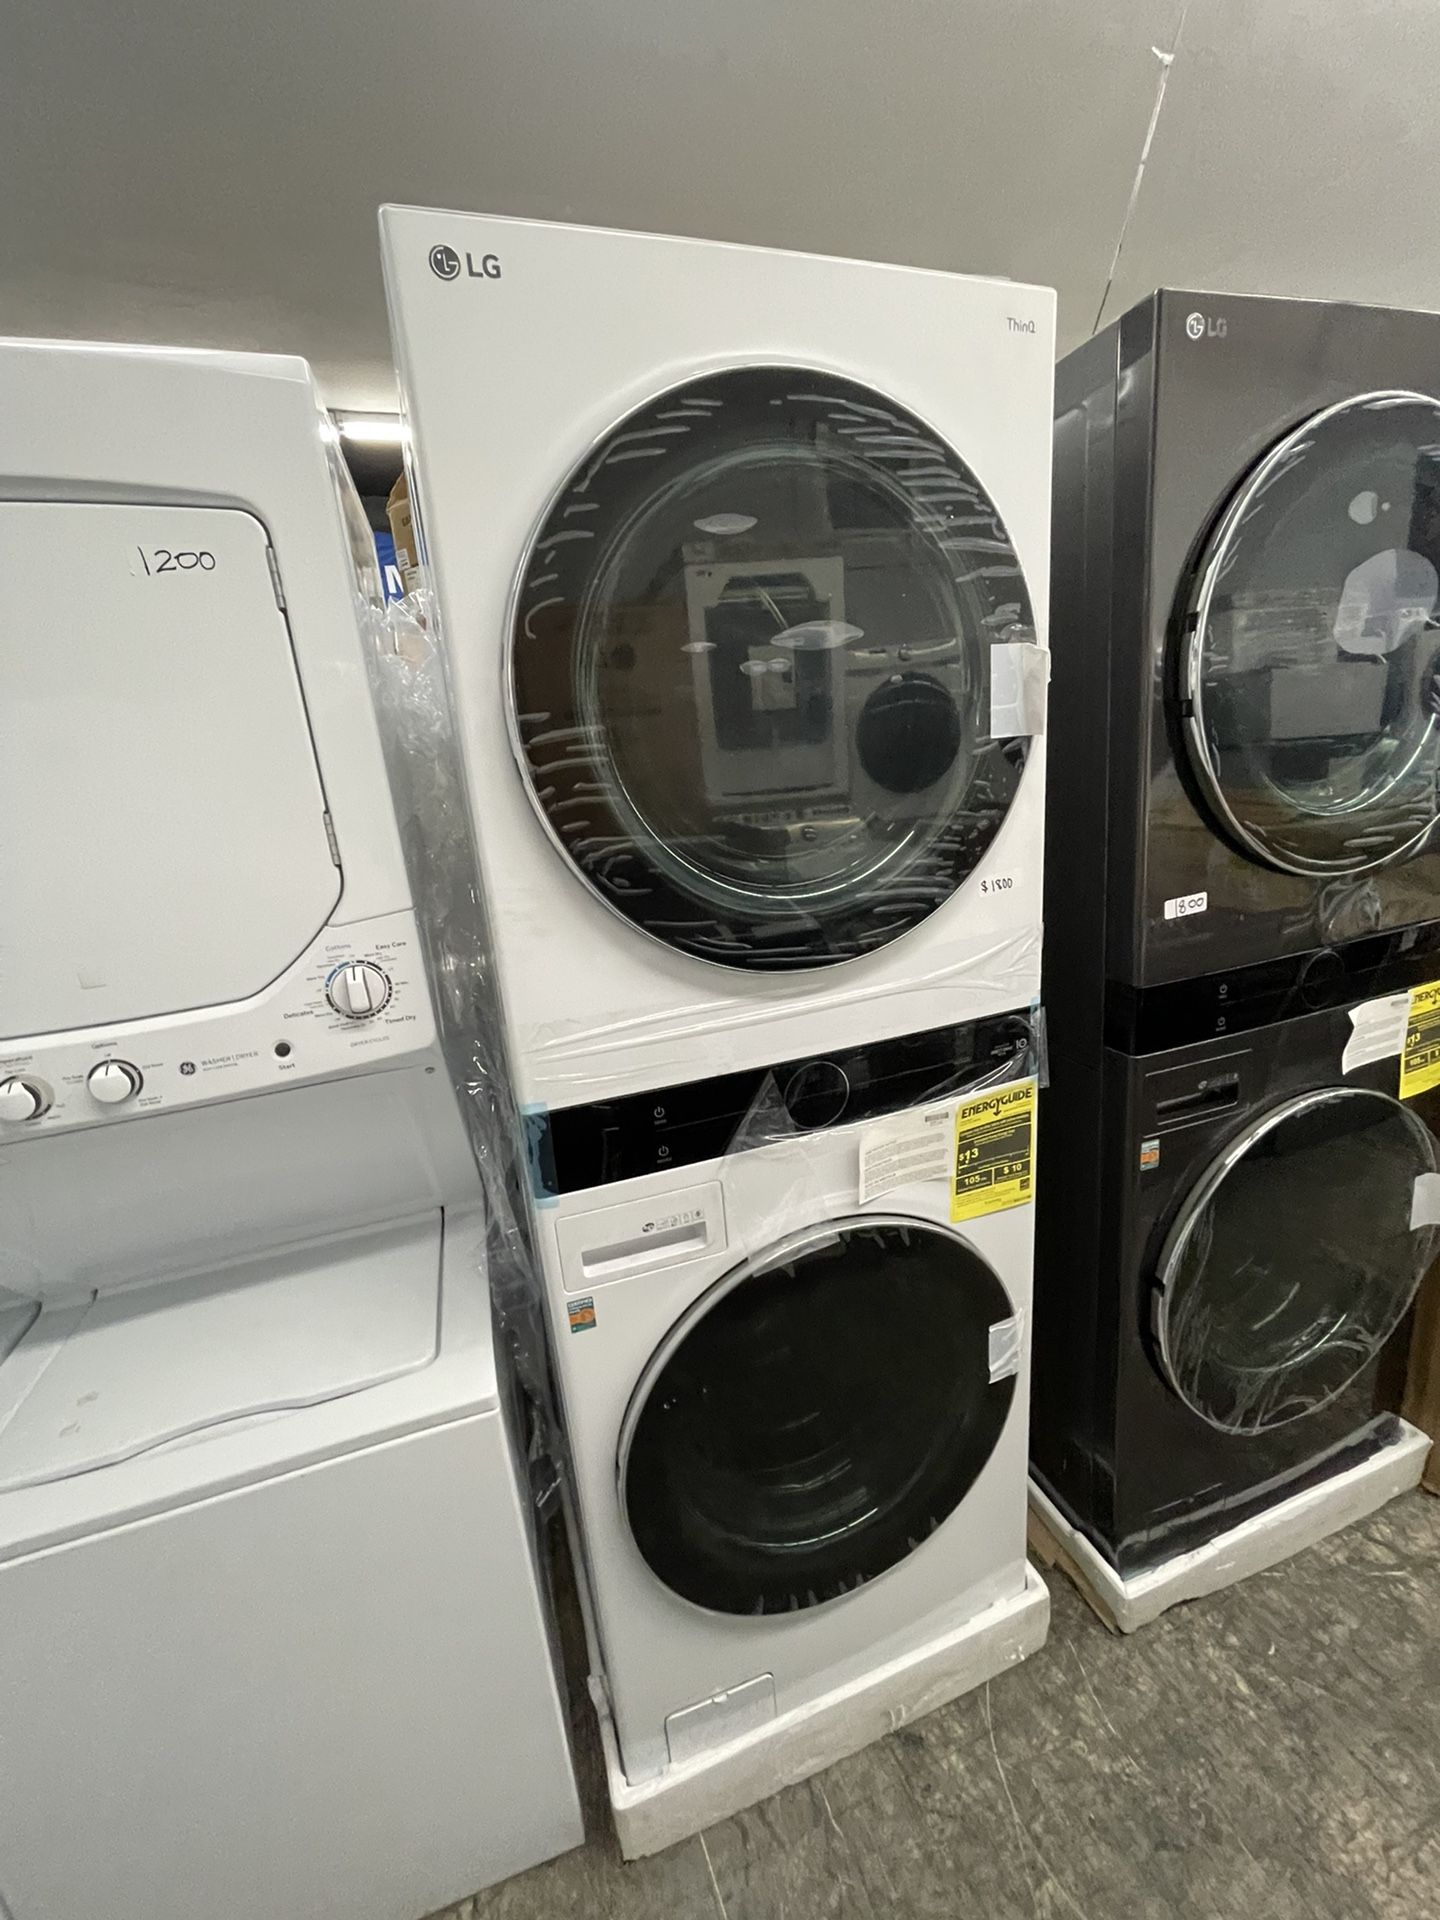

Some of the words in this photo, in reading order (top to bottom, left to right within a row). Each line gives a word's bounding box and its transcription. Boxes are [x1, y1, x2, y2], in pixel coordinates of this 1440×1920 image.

[466, 252, 502, 279] LG
[1007, 317, 1036, 333] ThinQ
[1207, 317, 1228, 338] LG
[137, 546, 216, 576] 1200
[375, 943, 391, 951] Easy
[391, 940, 407, 948] Care
[283, 1009, 314, 1019] Delicates
[201, 1056, 231, 1067] WASHER
[235, 1050, 259, 1061] DRYER
[278, 1062, 296, 1071] Start
[964, 1175, 980, 1186] 105
